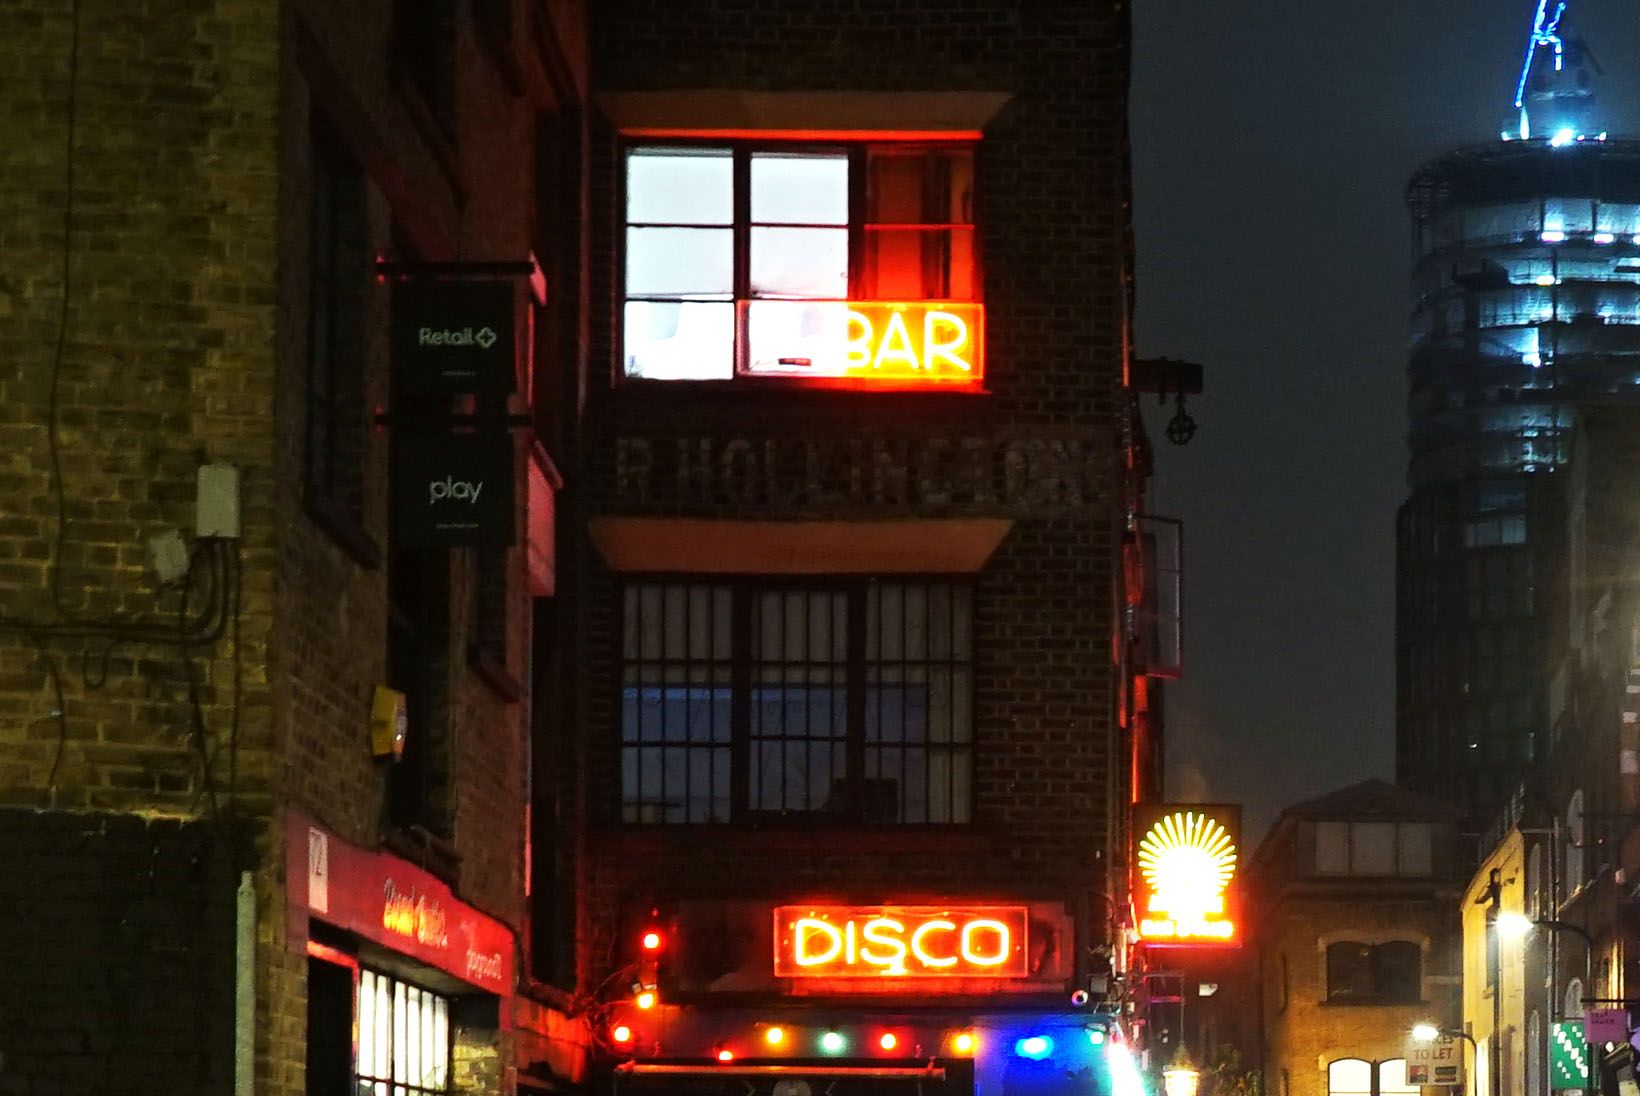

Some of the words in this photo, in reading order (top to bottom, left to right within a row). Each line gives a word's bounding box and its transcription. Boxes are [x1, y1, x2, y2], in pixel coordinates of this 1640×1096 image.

[418, 327, 474, 347] Retail
[846, 309, 972, 371] BAR
[429, 475, 484, 504] play
[795, 918, 1011, 968] DISCO
[1413, 1049, 1430, 1060] TO
[1432, 1047, 1453, 1060] LET
